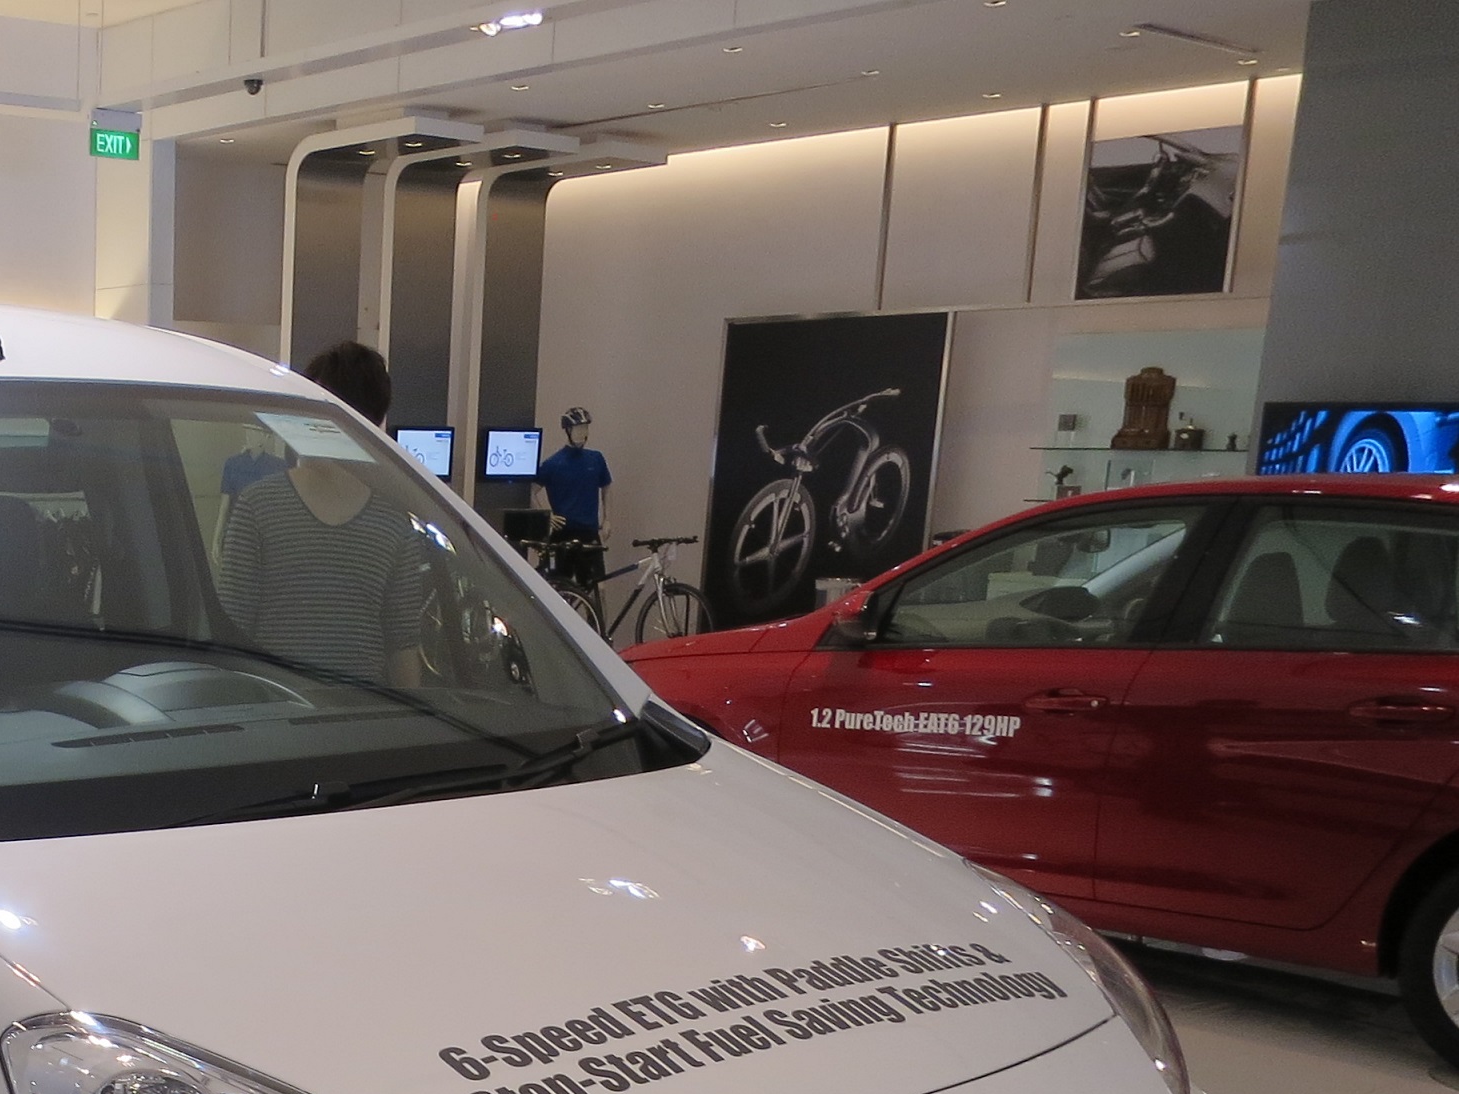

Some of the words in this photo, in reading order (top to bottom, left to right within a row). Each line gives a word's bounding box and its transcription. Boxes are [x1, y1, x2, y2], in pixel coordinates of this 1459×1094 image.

[96, 132, 125, 154] EXIT
[810, 707, 832, 729] 1.2
[834, 708, 915, 732] PureTech
[917, 711, 960, 735] EAT6
[963, 714, 1021, 738] 129HP
[439, 1007, 636, 1081] 6-Speed
[611, 991, 707, 1031] ETG
[687, 974, 789, 1013] with
[762, 955, 900, 996] Paddle
[877, 943, 986, 974] Shifts
[969, 943, 1012, 964] &
[678, 1015, 787, 1062] Fuel
[762, 994, 906, 1040] Saving
[876, 971, 1068, 1016] Technology
